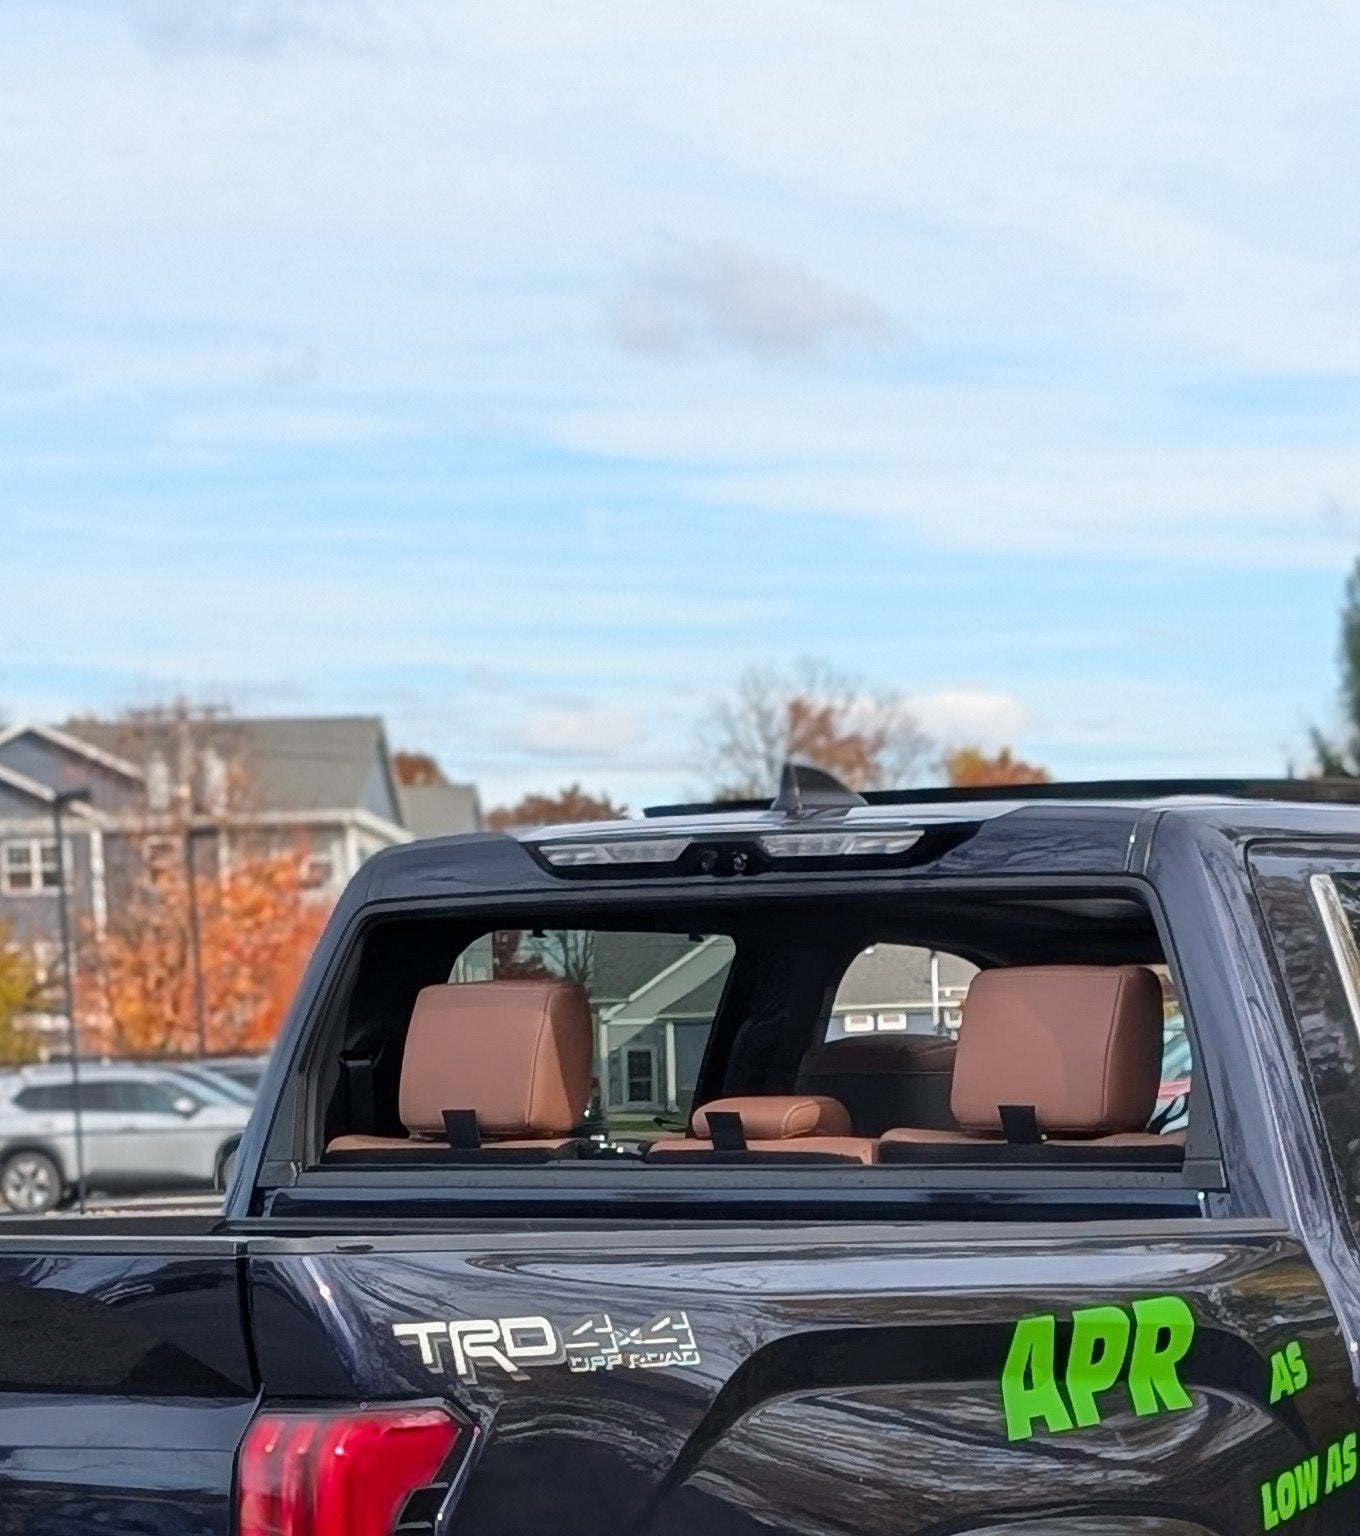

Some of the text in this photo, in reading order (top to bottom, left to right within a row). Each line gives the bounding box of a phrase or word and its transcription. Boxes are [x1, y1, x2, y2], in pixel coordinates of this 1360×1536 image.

[392, 1315, 561, 1380] TRD
[1001, 1296, 1195, 1440] APR
[1269, 1341, 1309, 1405] AS
[1261, 1432, 1358, 1531] LOW AS
